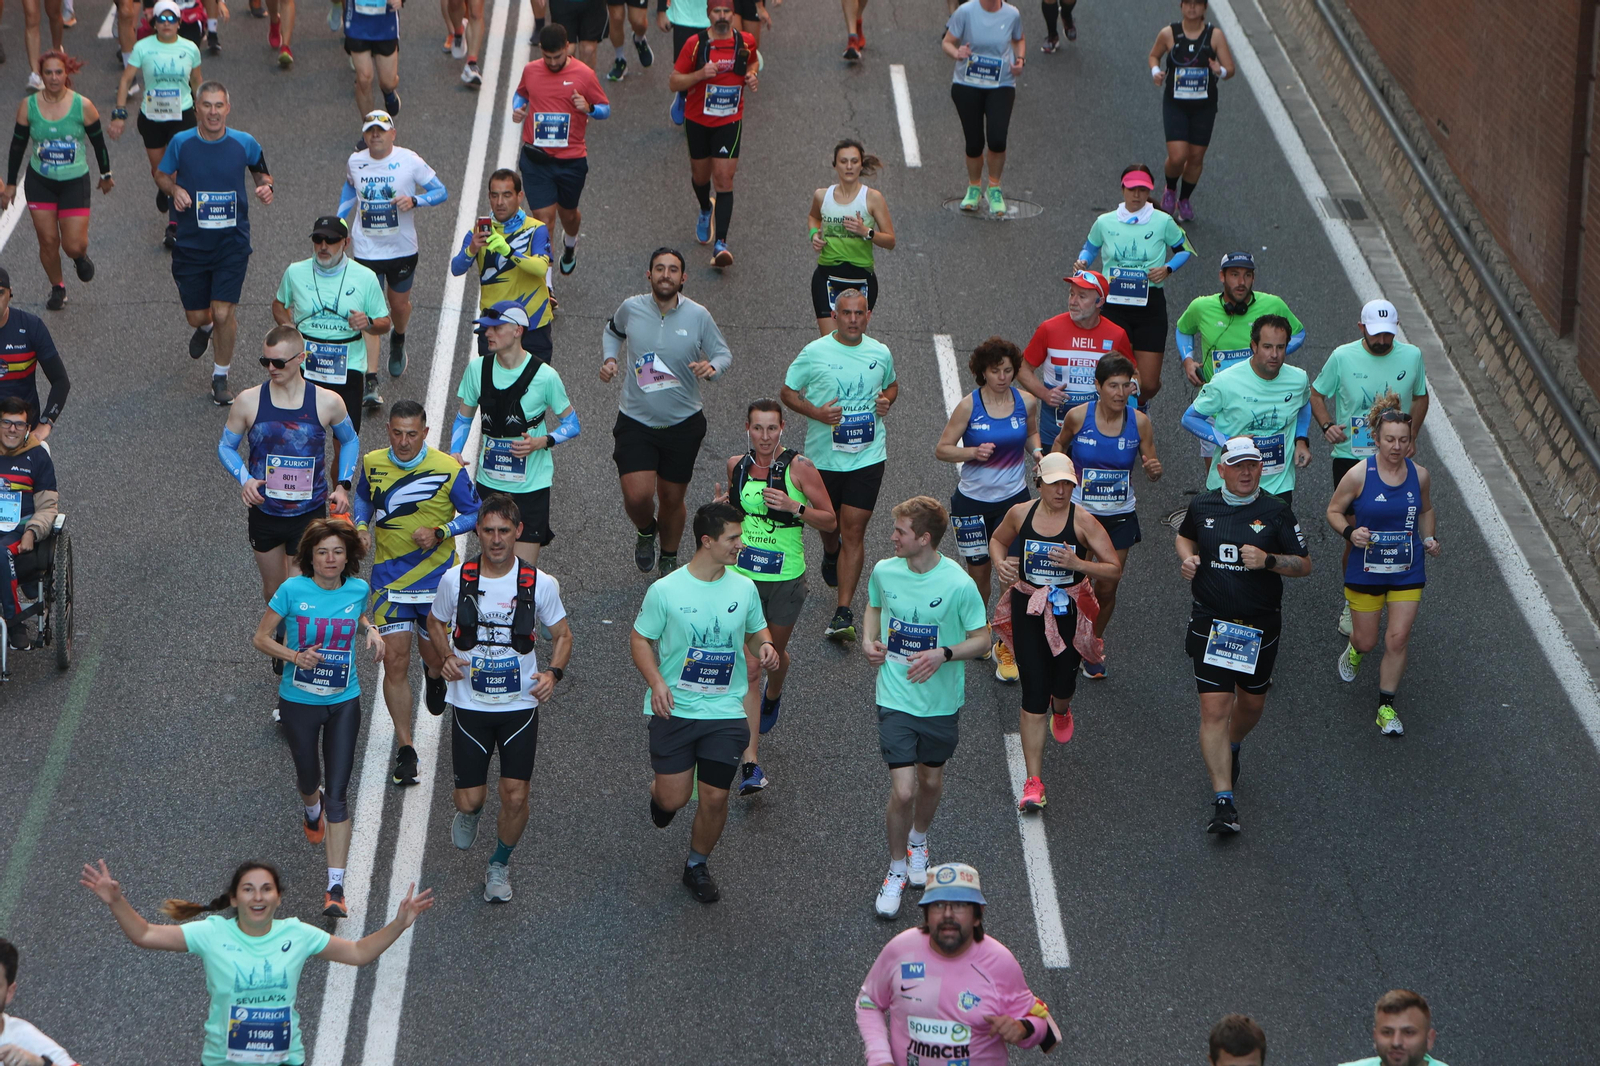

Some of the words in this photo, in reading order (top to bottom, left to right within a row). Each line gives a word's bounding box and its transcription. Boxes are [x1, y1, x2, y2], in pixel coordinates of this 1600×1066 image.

[360, 176, 395, 184] MADRID
[1120, 282, 1136, 290] 13104
[310, 322, 347, 332] SEVILLA'24
[1072, 337, 1097, 349] NEIL
[320, 346, 343, 354] ZURICH
[1227, 351, 1250, 359] ZURICH
[317, 358, 334, 366] 12000
[1070, 358, 1096, 367] TEEN
[1070, 375, 1096, 385] TRUS
[848, 415, 870, 423] ZURICH
[495, 454, 512, 464] 12994
[283, 460, 309, 468] ZURICH
[282, 473, 298, 482] 8011
[1404, 506, 1417, 530] GREAT
[1382, 534, 1406, 542] ZURICH
[1031, 568, 1055, 576] CARMEN
[1055, 568, 1066, 576] LUZ
[903, 626, 931, 635] ZURICH
[1229, 627, 1256, 639] ZURICH
[901, 639, 921, 649] 12400
[1224, 641, 1244, 652] 11572
[705, 654, 732, 662] ZURICH
[1215, 648, 1231, 658] MUXO
[1232, 652, 1248, 662] BETIS
[487, 660, 515, 669] ZURICH
[312, 668, 334, 677] 12810
[699, 667, 719, 676] 12399
[312, 677, 330, 687] ANITA
[485, 676, 506, 684] 12387
[697, 676, 716, 685] BLAKE
[485, 686, 507, 694] FERENC
[909, 964, 923, 974] NV
[236, 994, 286, 1005] SEVILLA'24
[251, 1010, 285, 1020] ZURICH
[909, 1020, 948, 1035] spusu
[245, 1041, 275, 1051] ANGELA
